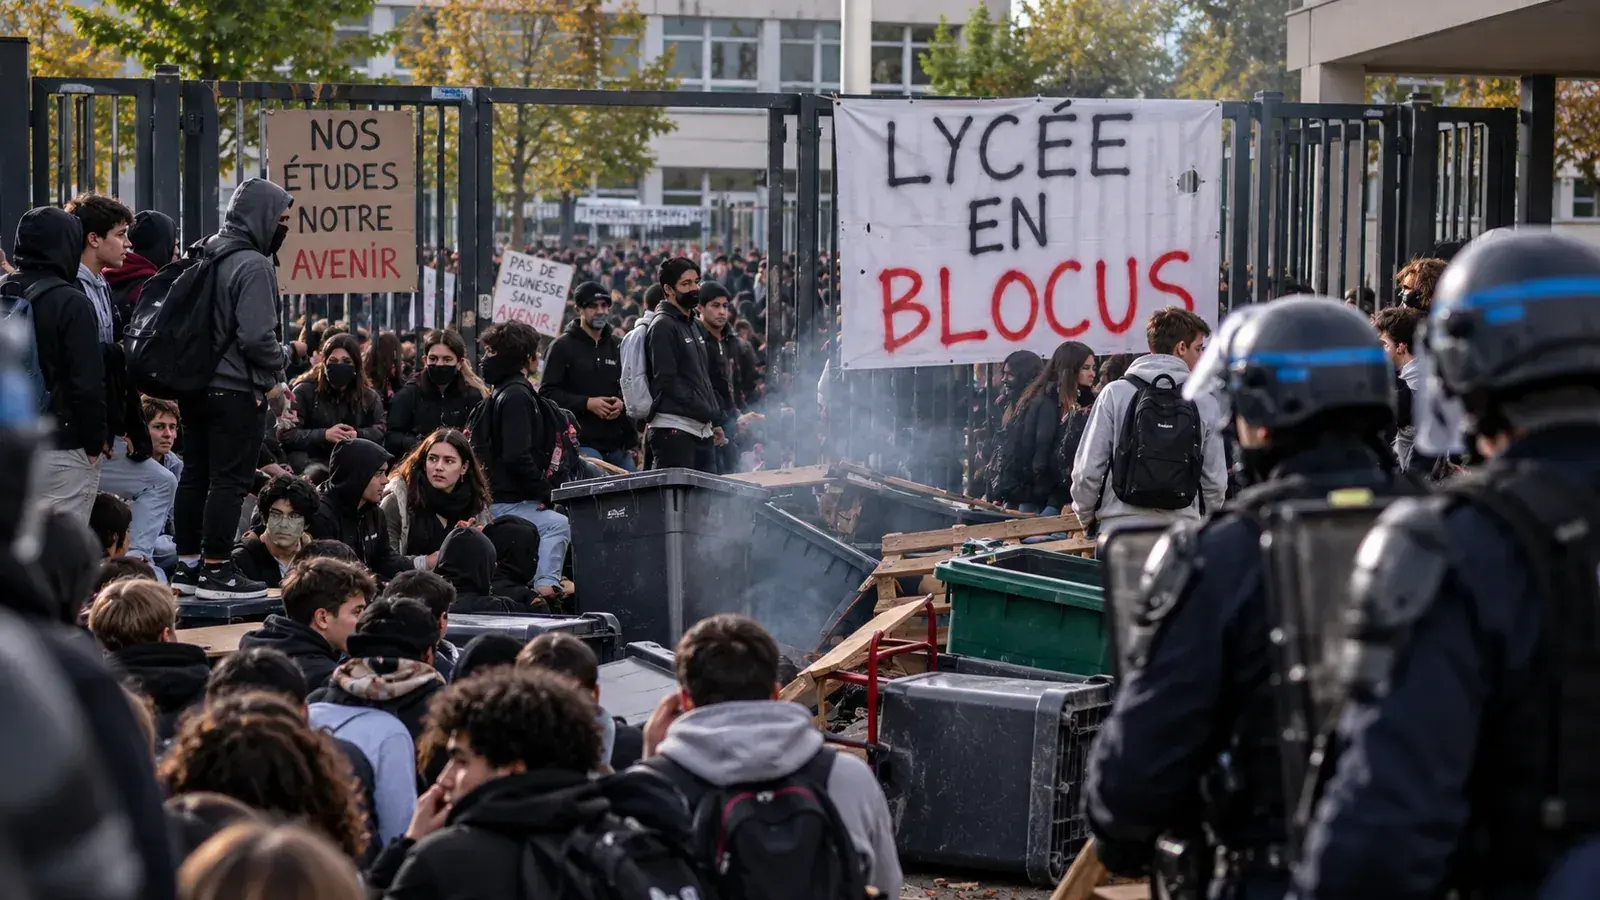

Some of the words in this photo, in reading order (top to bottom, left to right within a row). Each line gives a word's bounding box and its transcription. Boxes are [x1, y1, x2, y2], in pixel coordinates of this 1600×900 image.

[311, 118, 381, 151] NOS
[886, 99, 1133, 187] LYCÉE
[283, 154, 399, 191] ÉTUDES
[298, 204, 393, 234] NOTRE
[968, 191, 1048, 255] EN
[509, 255, 533, 272] PAS
[540, 263, 557, 279] DE
[502, 272, 564, 299] JEUNESSE
[510, 290, 542, 308] SANS
[878, 250, 1195, 354] BLOCUS
